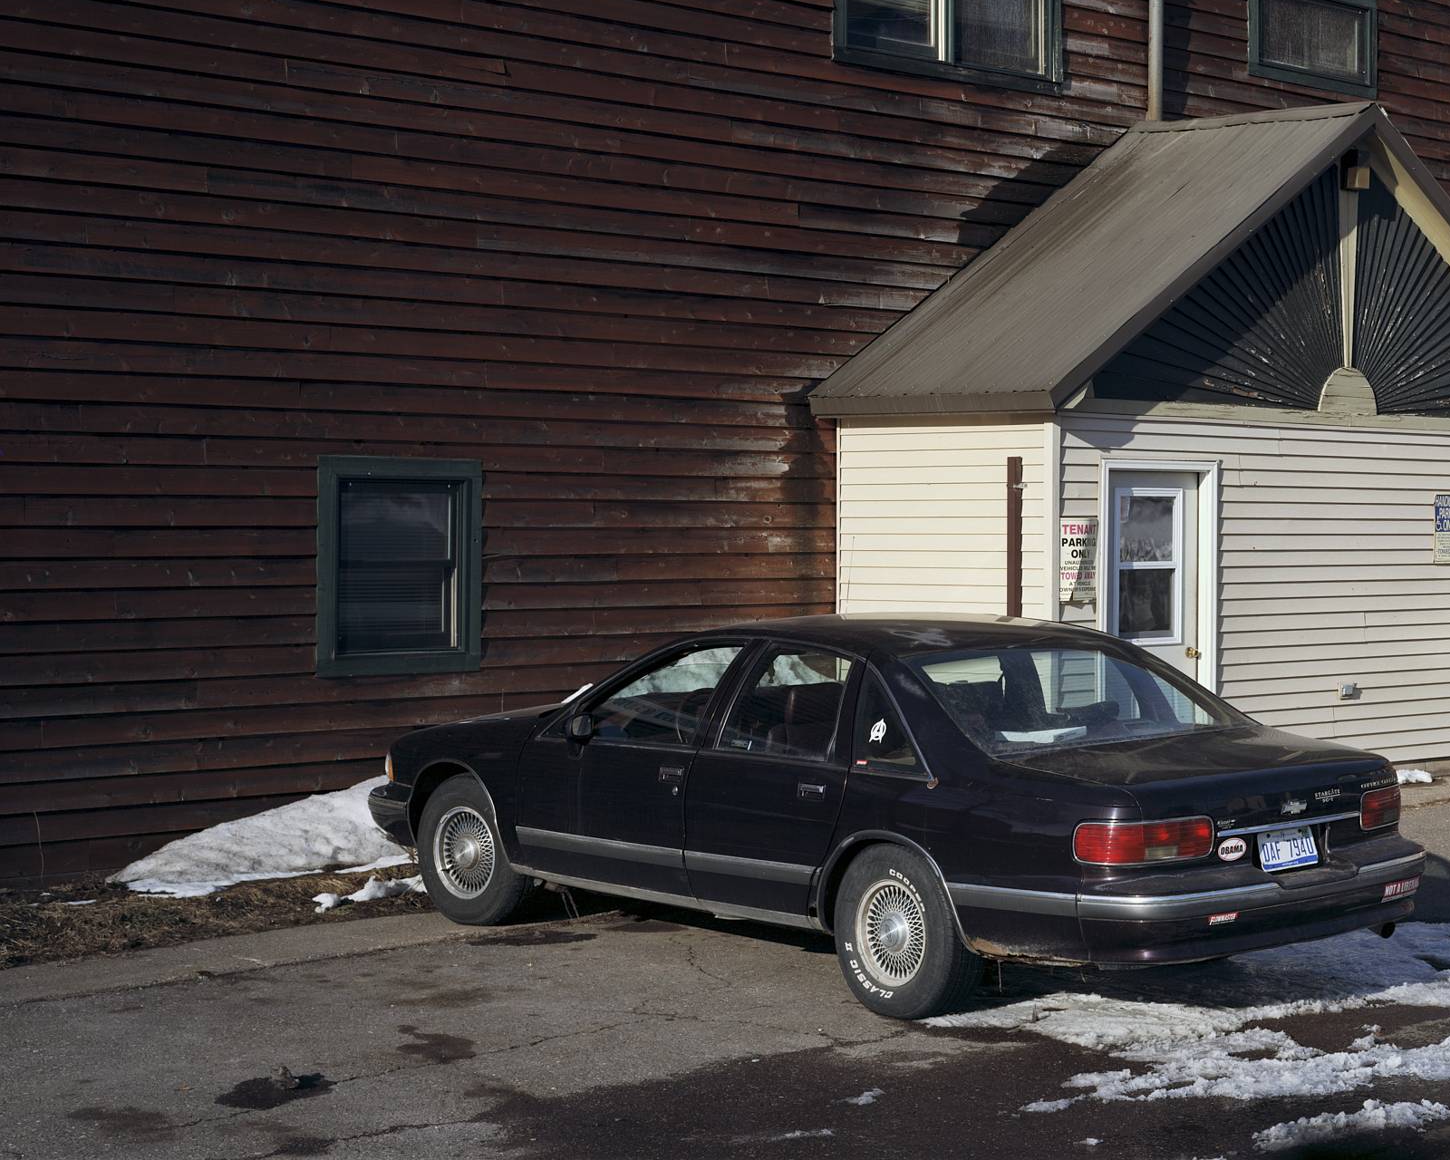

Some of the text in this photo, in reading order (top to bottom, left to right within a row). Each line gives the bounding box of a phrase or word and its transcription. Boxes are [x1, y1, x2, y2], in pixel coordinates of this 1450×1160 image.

[1062, 524, 1096, 535] TENANT
[1071, 549, 1090, 558] ONLY
[889, 868, 926, 913] COOPER
[1384, 884, 1397, 896] NOT
[849, 959, 894, 999] CLASSIC
